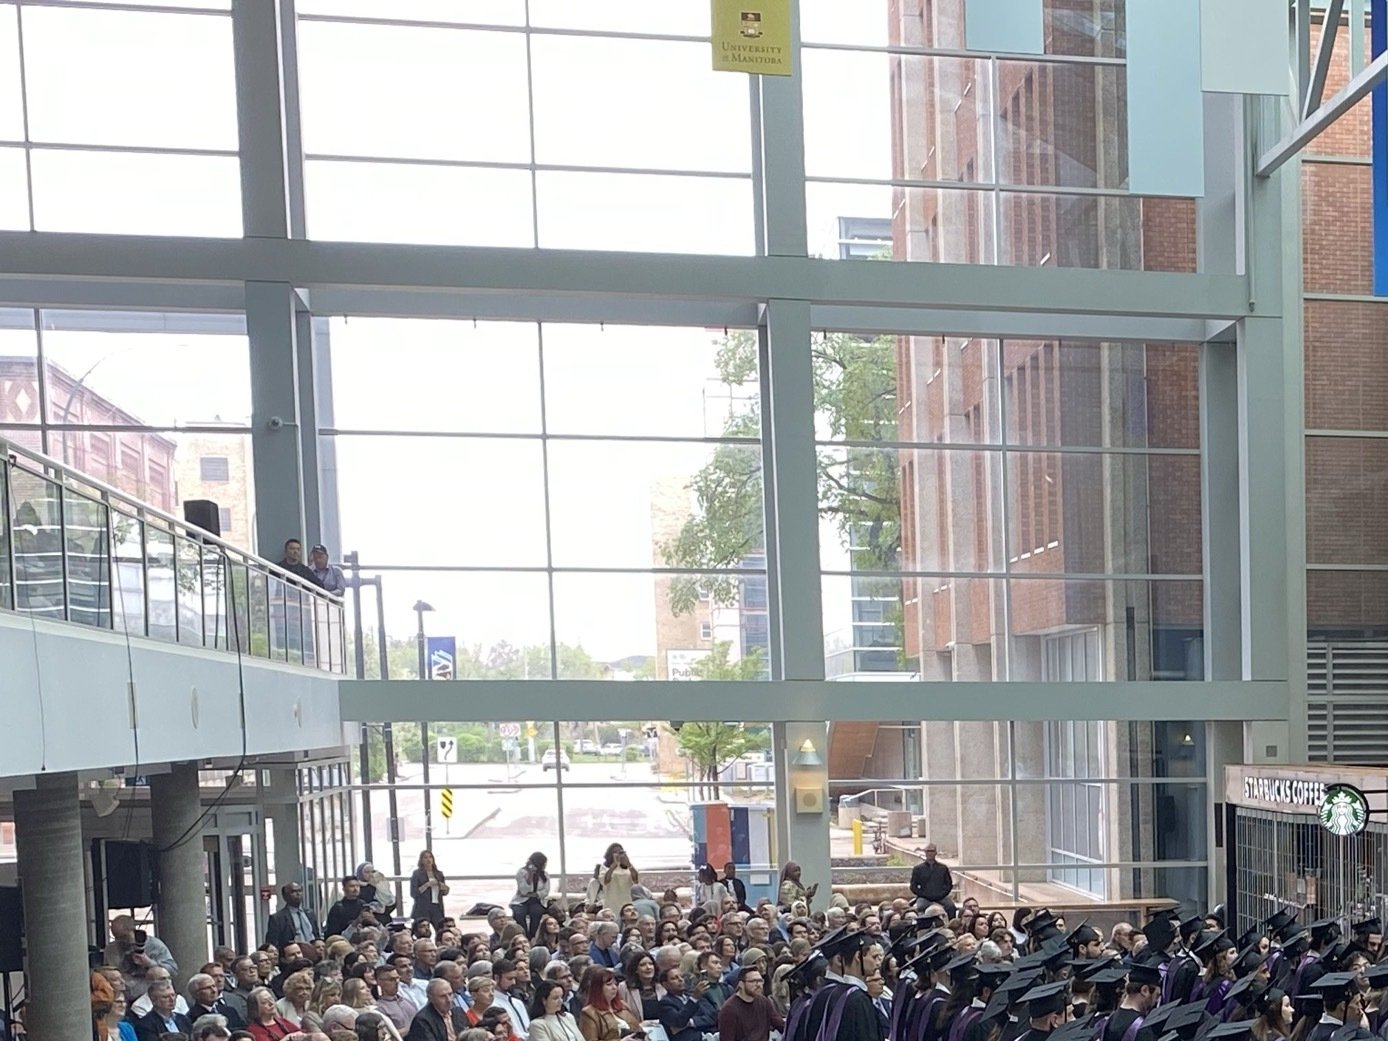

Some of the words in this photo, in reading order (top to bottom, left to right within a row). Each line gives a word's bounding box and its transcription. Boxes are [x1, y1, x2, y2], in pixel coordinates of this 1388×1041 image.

[721, 41, 782, 54] UNIVERSITY
[731, 53, 782, 64] MANITOBA
[1244, 776, 1291, 804] STARBUCKS
[1292, 780, 1325, 806] COFFEE
